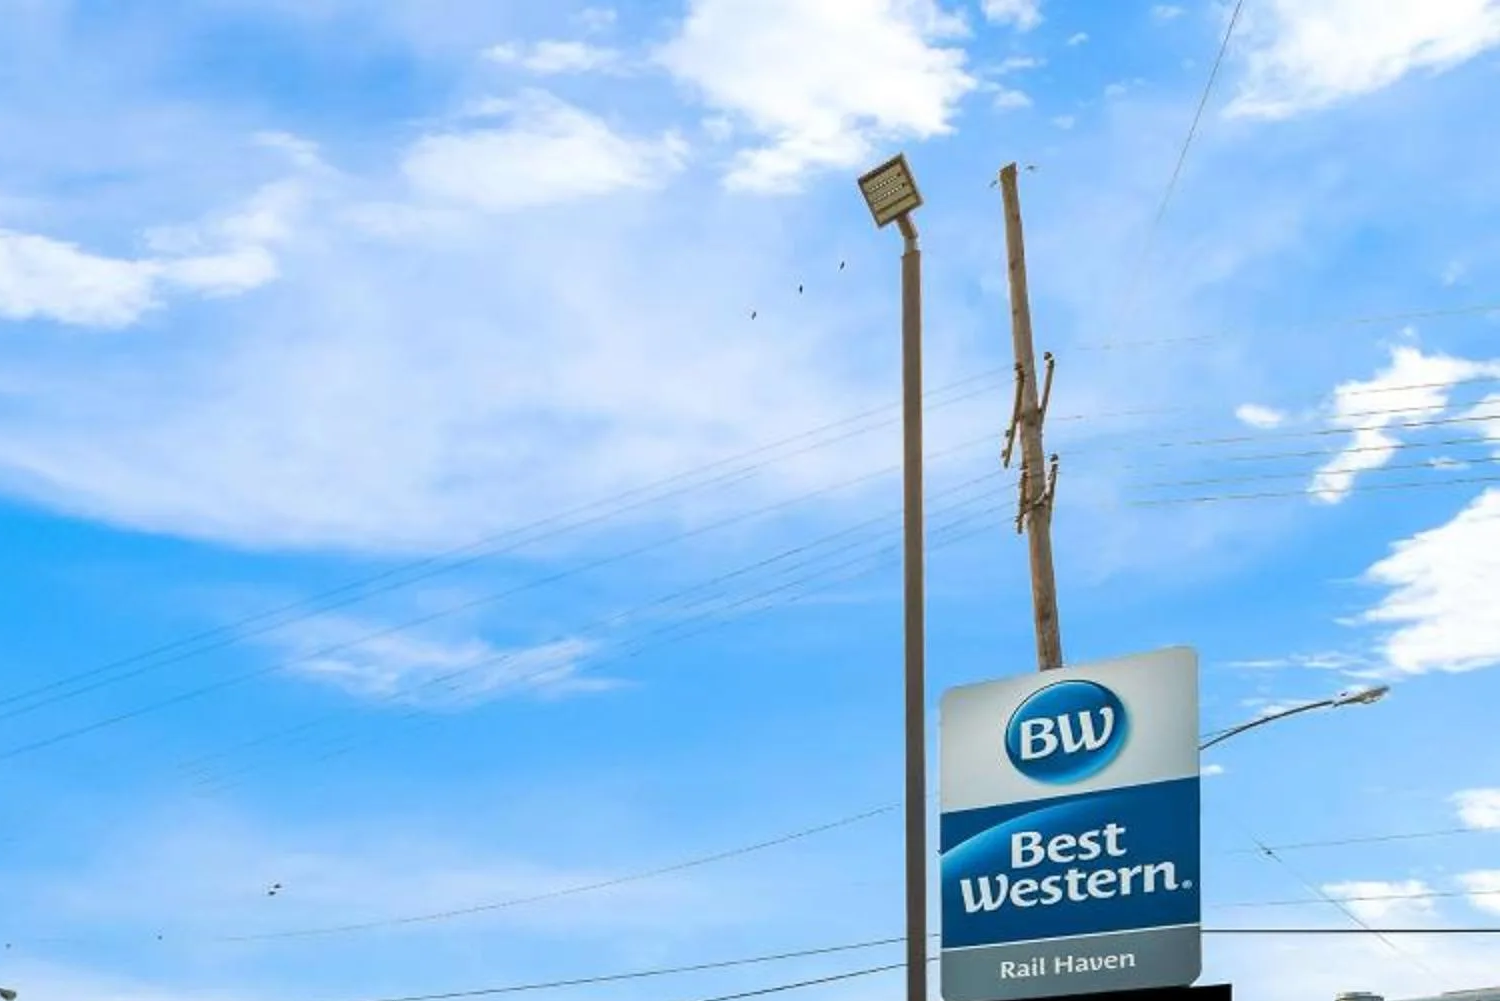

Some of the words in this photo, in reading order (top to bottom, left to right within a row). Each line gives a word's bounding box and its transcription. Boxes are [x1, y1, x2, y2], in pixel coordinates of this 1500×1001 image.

[1019, 706, 1116, 761] BW
[1011, 822, 1126, 868] Best
[1001, 959, 1046, 979] Rail
[1055, 952, 1136, 976] Haven
